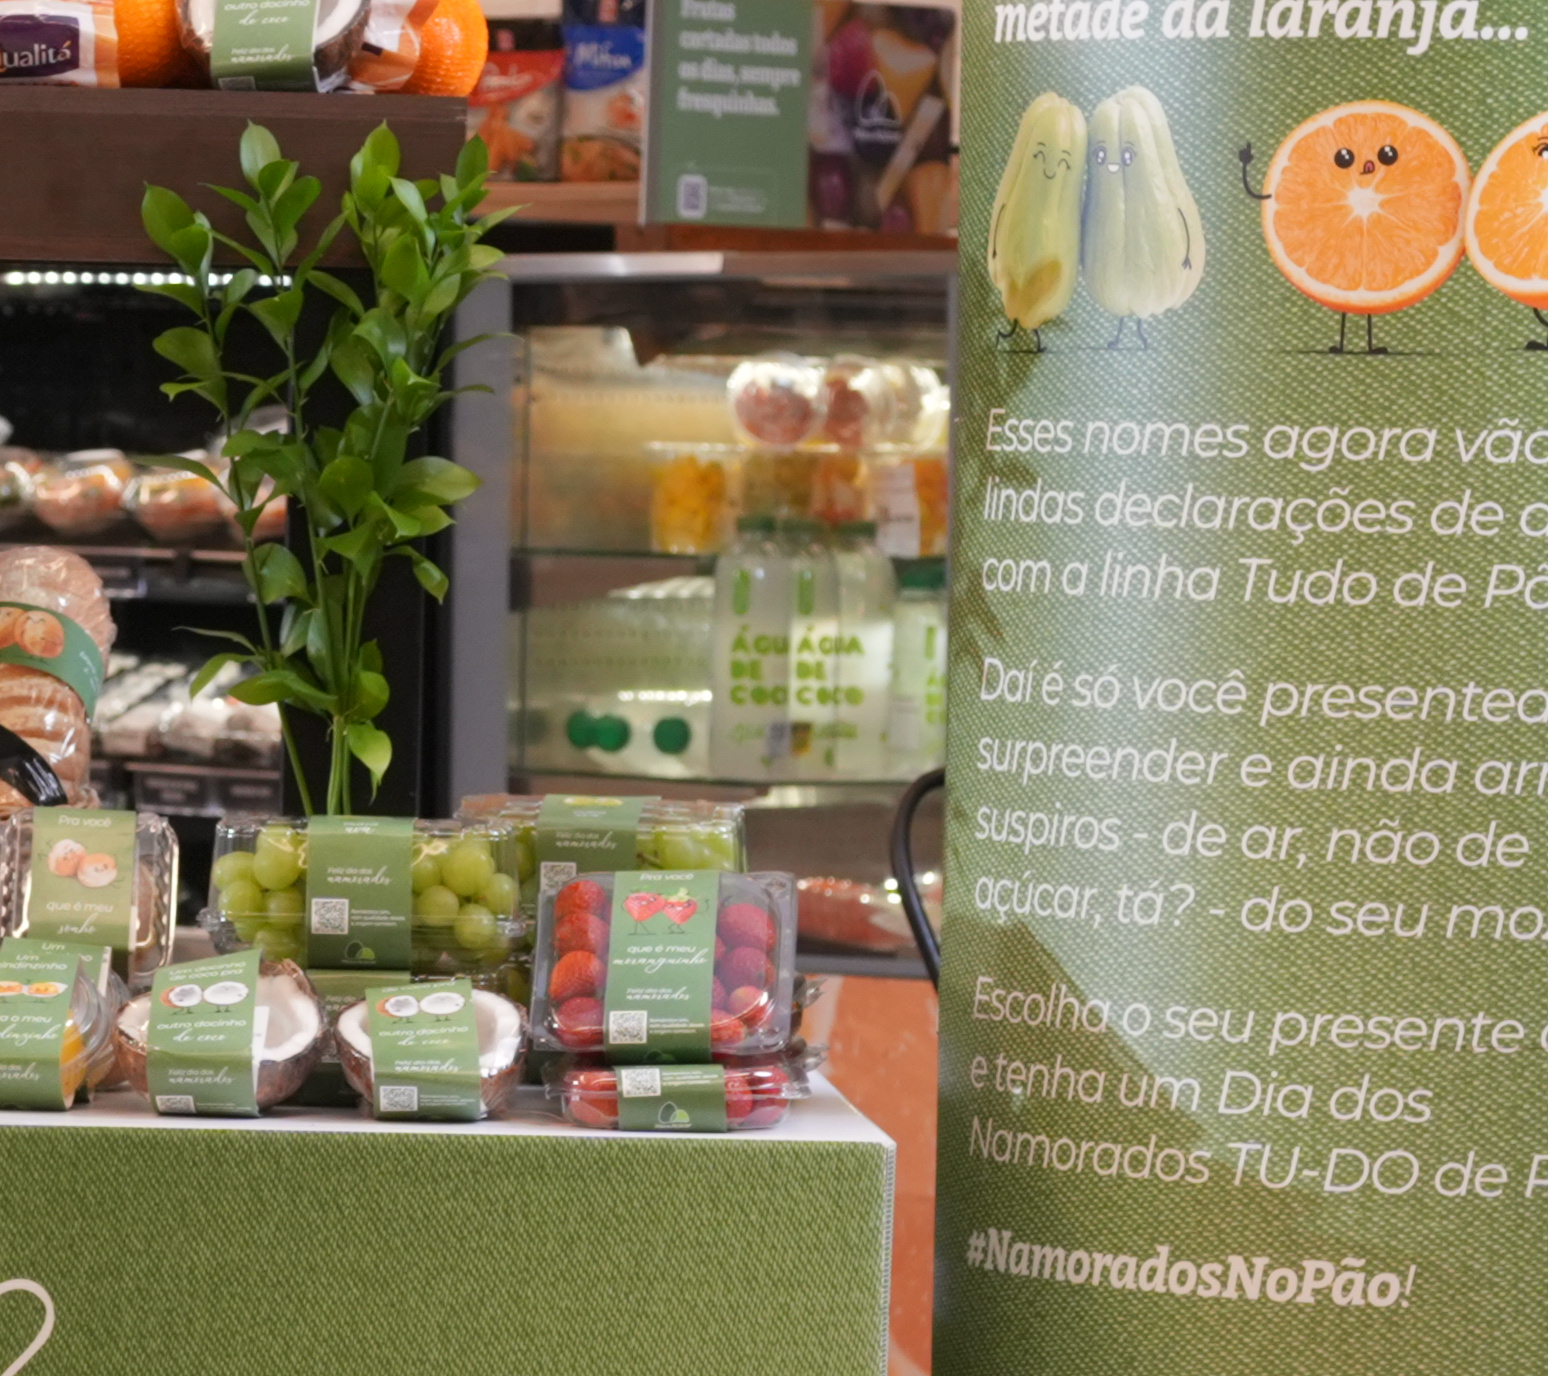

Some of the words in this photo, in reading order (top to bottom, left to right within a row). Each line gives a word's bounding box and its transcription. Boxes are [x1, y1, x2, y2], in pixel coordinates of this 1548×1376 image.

[985, 407, 1073, 455] Esses
[1082, 421, 1249, 458] nomes
[1263, 422, 1436, 472] agora
[982, 476, 1085, 525] lindas
[1094, 482, 1416, 545] declarações
[1430, 488, 1504, 536] de
[981, 556, 1051, 594] com
[1061, 559, 1087, 595] a
[1098, 552, 1221, 603] linha
[1238, 556, 1379, 606] Tudo
[1392, 562, 1466, 608] de
[627, 945, 652, 954] que
[965, 1226, 1417, 1309] #NamoradosNoPão!
